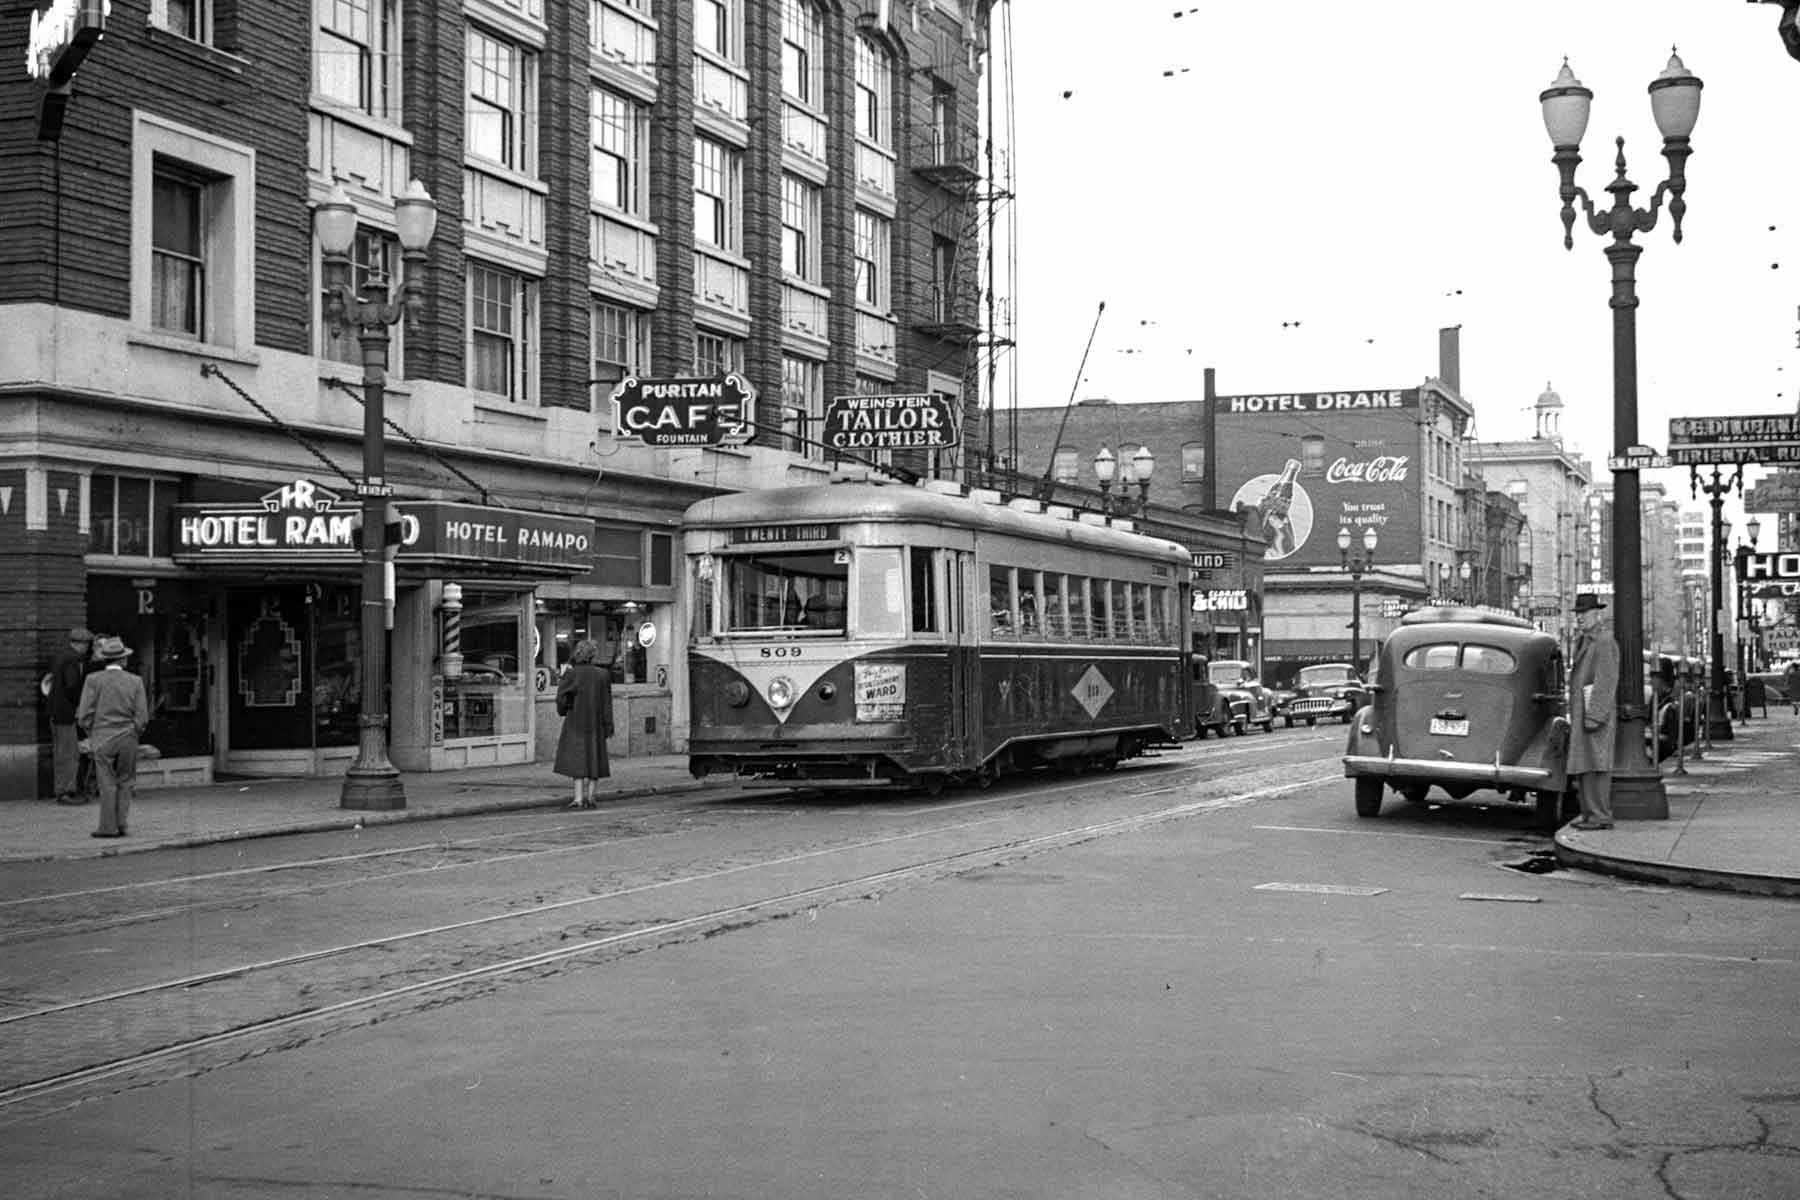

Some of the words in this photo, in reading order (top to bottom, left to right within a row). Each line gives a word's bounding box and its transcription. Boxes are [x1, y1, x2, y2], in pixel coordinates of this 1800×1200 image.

[642, 384, 722, 399] PURITAN
[848, 397, 931, 409] WEINSTEIN
[1231, 394, 1306, 412] HOTEL
[1316, 391, 1403, 410] DRAKE
[626, 404, 739, 429] CAFE
[837, 407, 943, 431] TAILOR
[656, 434, 708, 444] FOUNTAIN
[1651, 455, 1672, 468] AVE
[1678, 447, 1770, 463] ORIENTAL
[1343, 501, 1359, 512] You
[1362, 503, 1384, 512] trust
[1355, 513, 1389, 527] quality
[181, 516, 278, 546] HOTEL
[285, 516, 420, 547] RAMO
[446, 520, 508, 543] HOTEL
[518, 528, 588, 552] RAMAPO
[1746, 554, 1800, 578] HO
[1576, 583, 1614, 594] HOTEL
[760, 647, 802, 658] 809
[866, 685, 897, 699] WARD
[433, 690, 441, 742] SHINE
